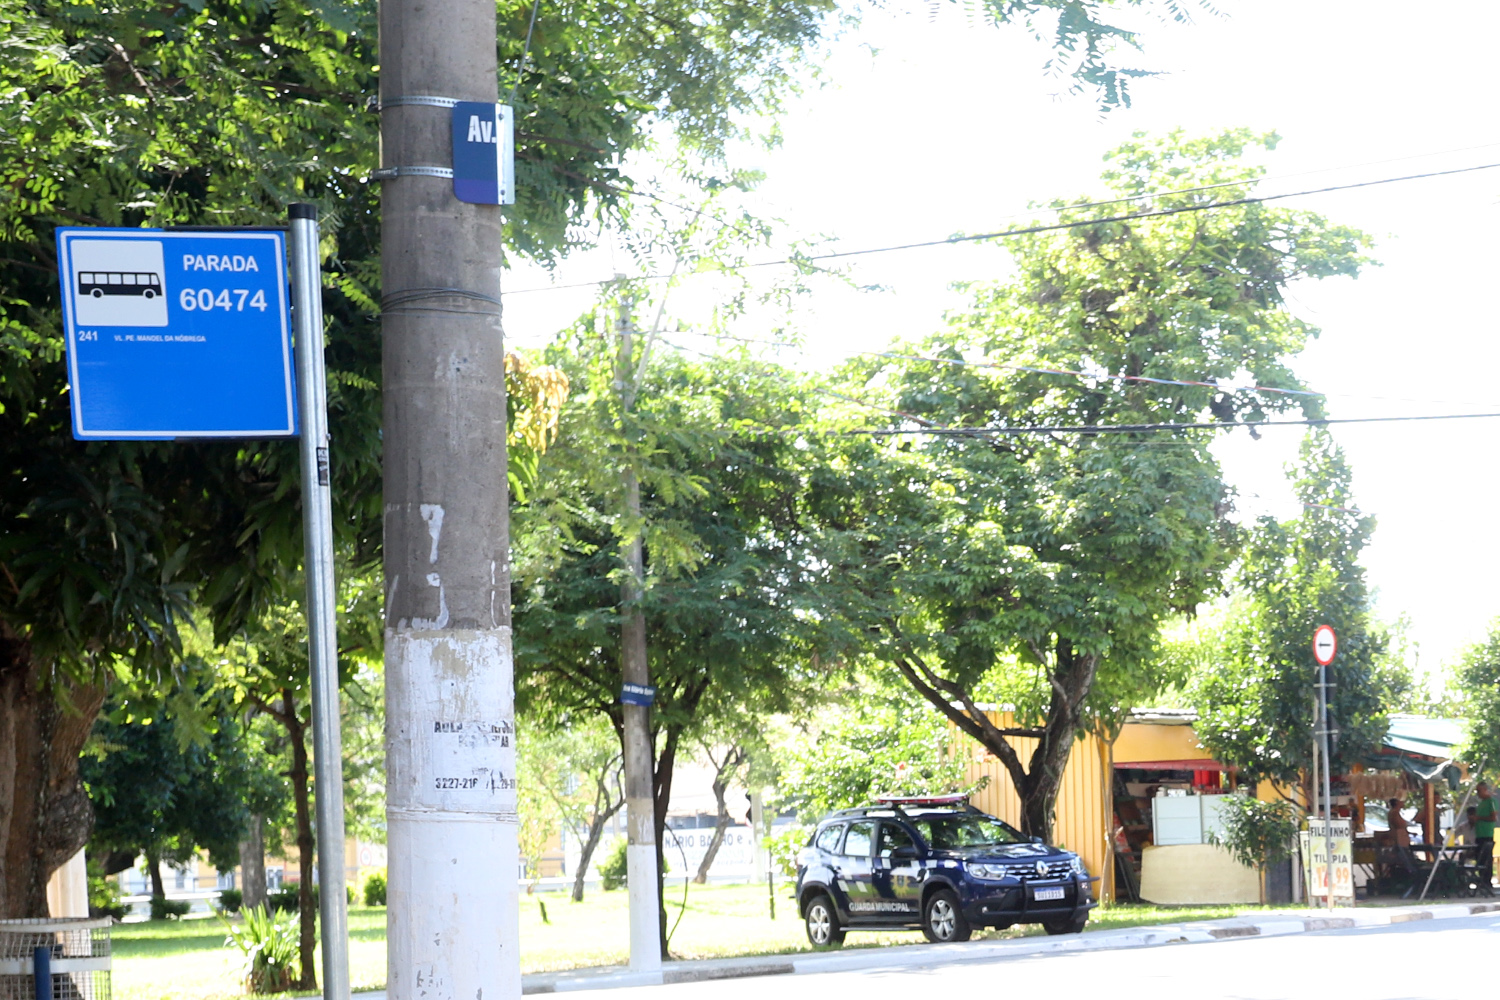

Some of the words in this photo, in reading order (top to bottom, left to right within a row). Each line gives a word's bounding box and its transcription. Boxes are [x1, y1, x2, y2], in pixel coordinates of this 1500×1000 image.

[468, 115, 496, 144] Av.
[183, 254, 258, 272] PARADA
[180, 288, 268, 312] 60474
[79, 331, 98, 341] 241
[174, 334, 206, 342] NÓBREGA
[1310, 827, 1350, 838] FILEINHO
[1314, 854, 1348, 864] TILPIA
[849, 902, 876, 912] GUARDA
[876, 902, 910, 912] MUNICIPAL
